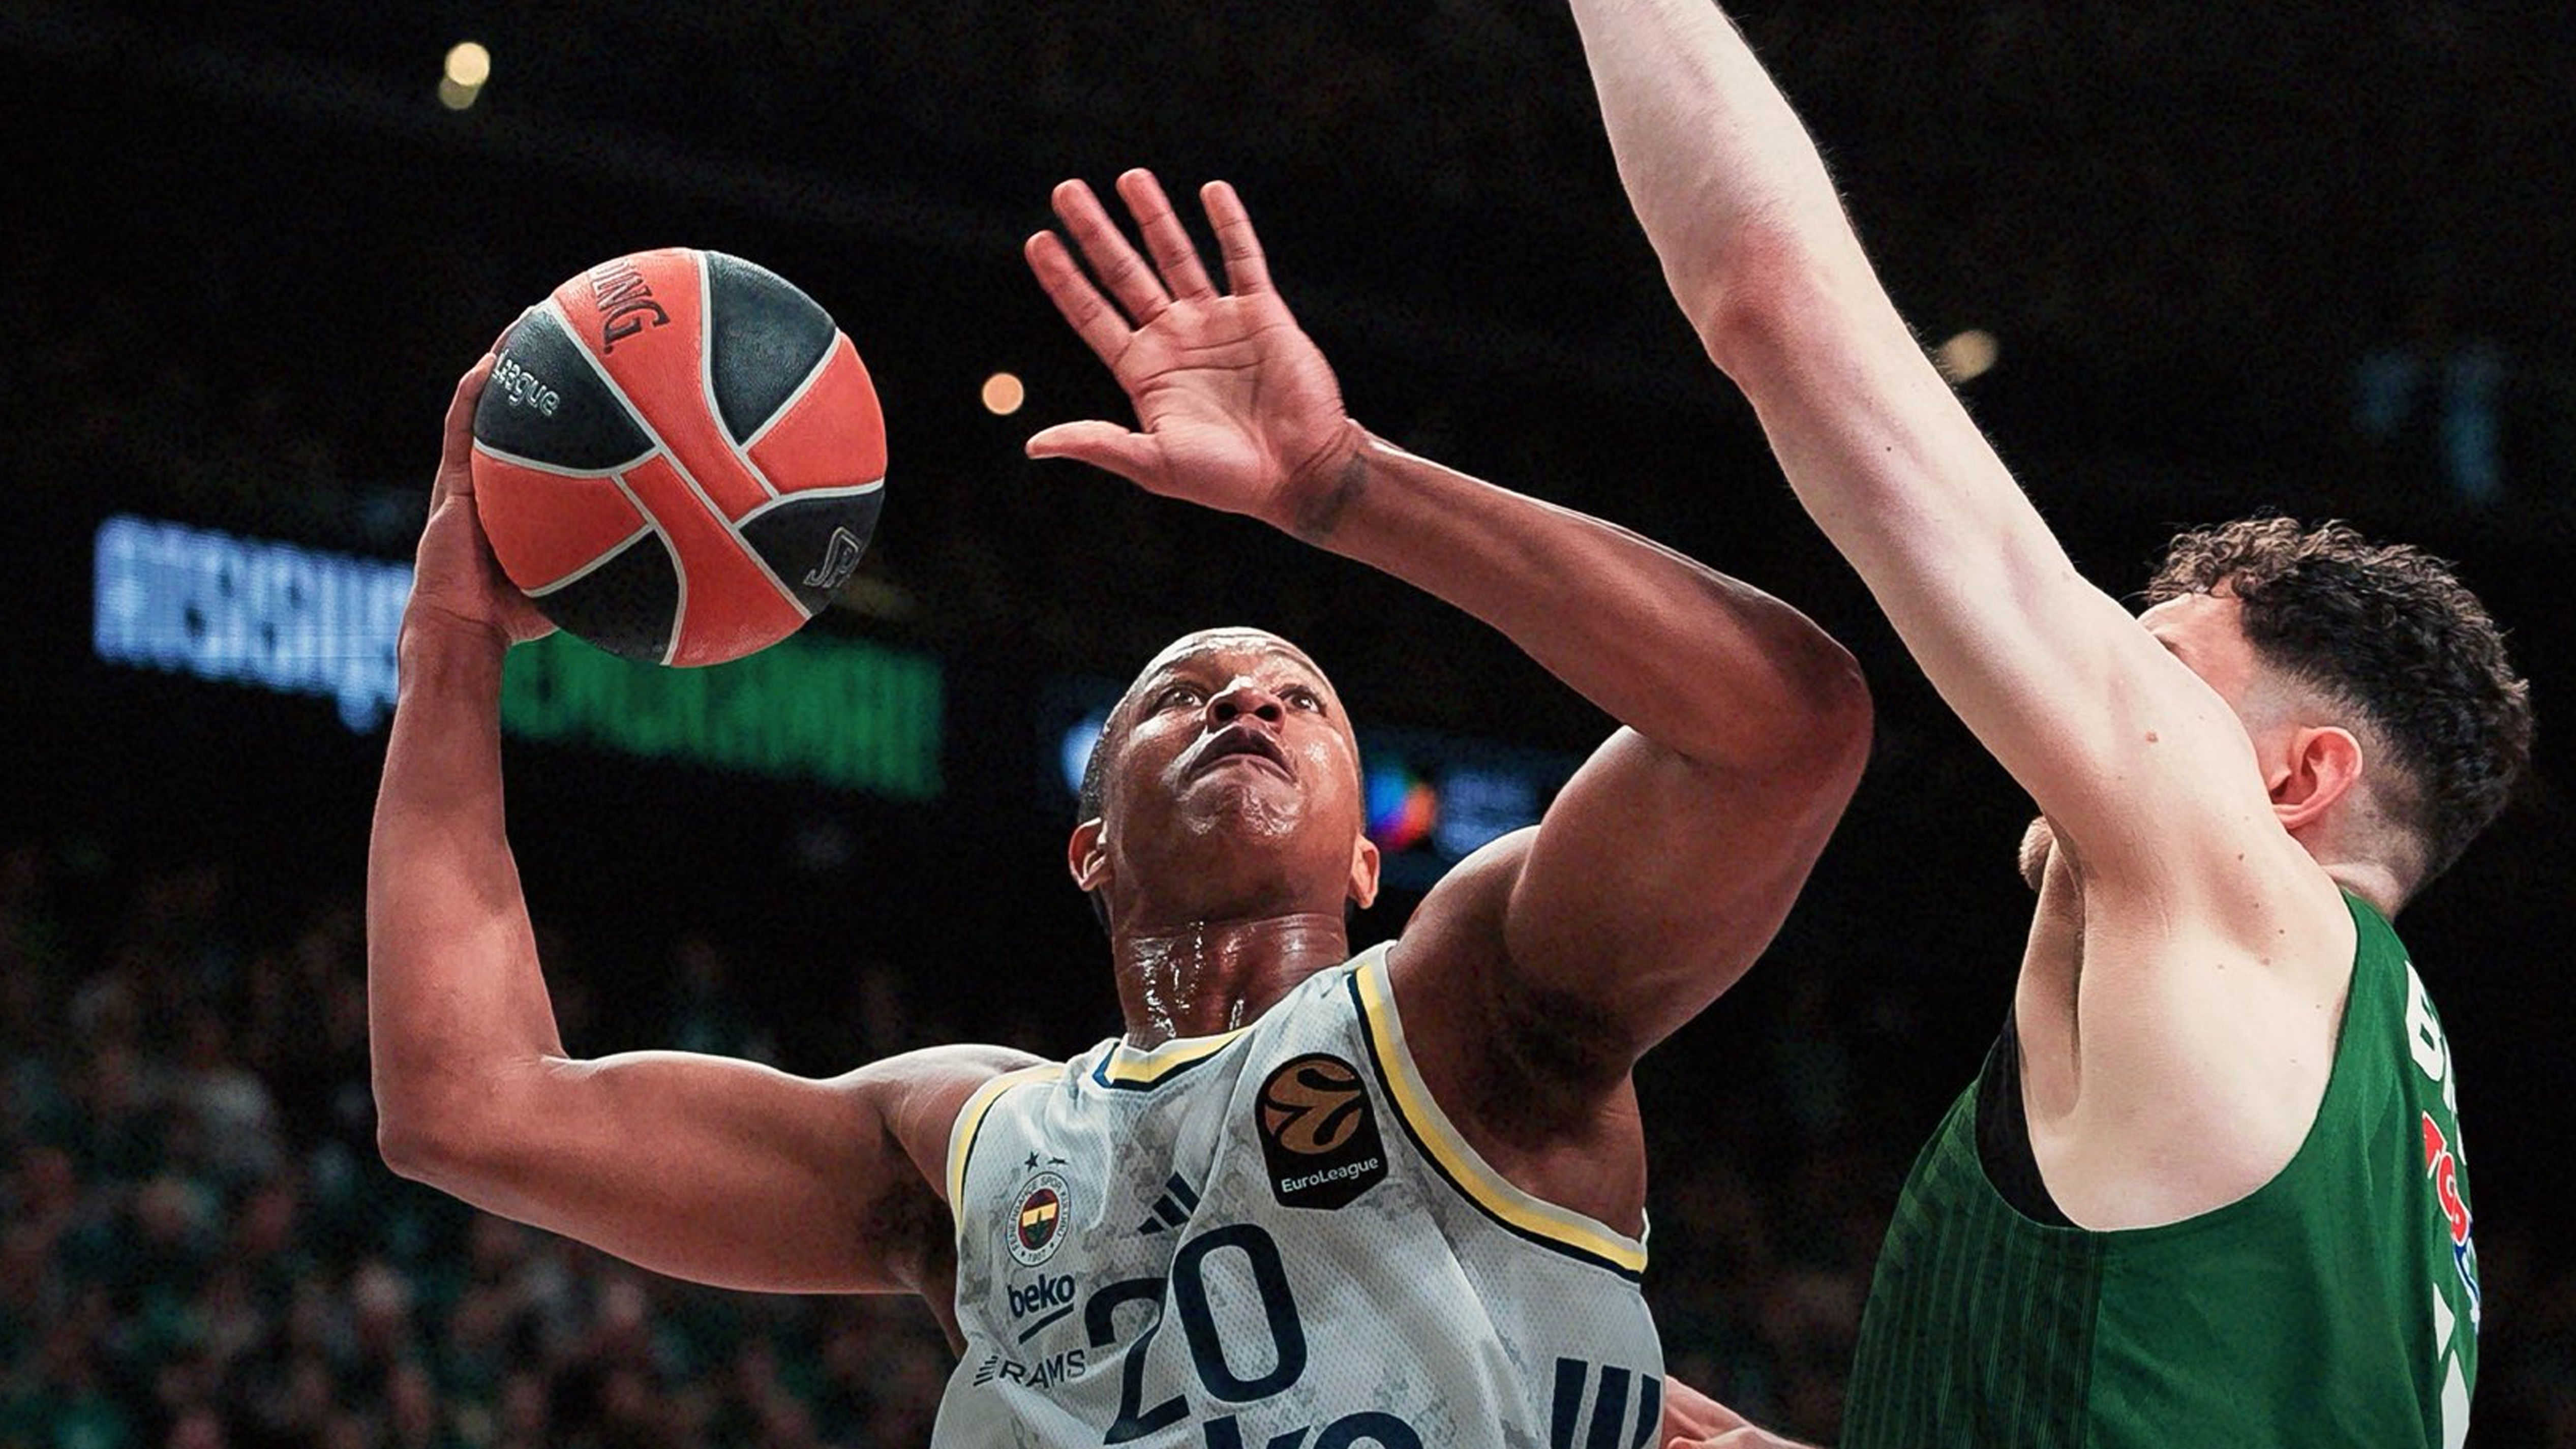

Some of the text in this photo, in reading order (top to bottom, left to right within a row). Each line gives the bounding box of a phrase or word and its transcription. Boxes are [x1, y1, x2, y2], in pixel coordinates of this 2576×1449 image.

[1281, 1158, 1378, 1193] EuroLeague
[1007, 1273, 1075, 1318] beko
[1084, 1223, 1308, 1445] 20
[999, 1349, 1086, 1388] RAMS
